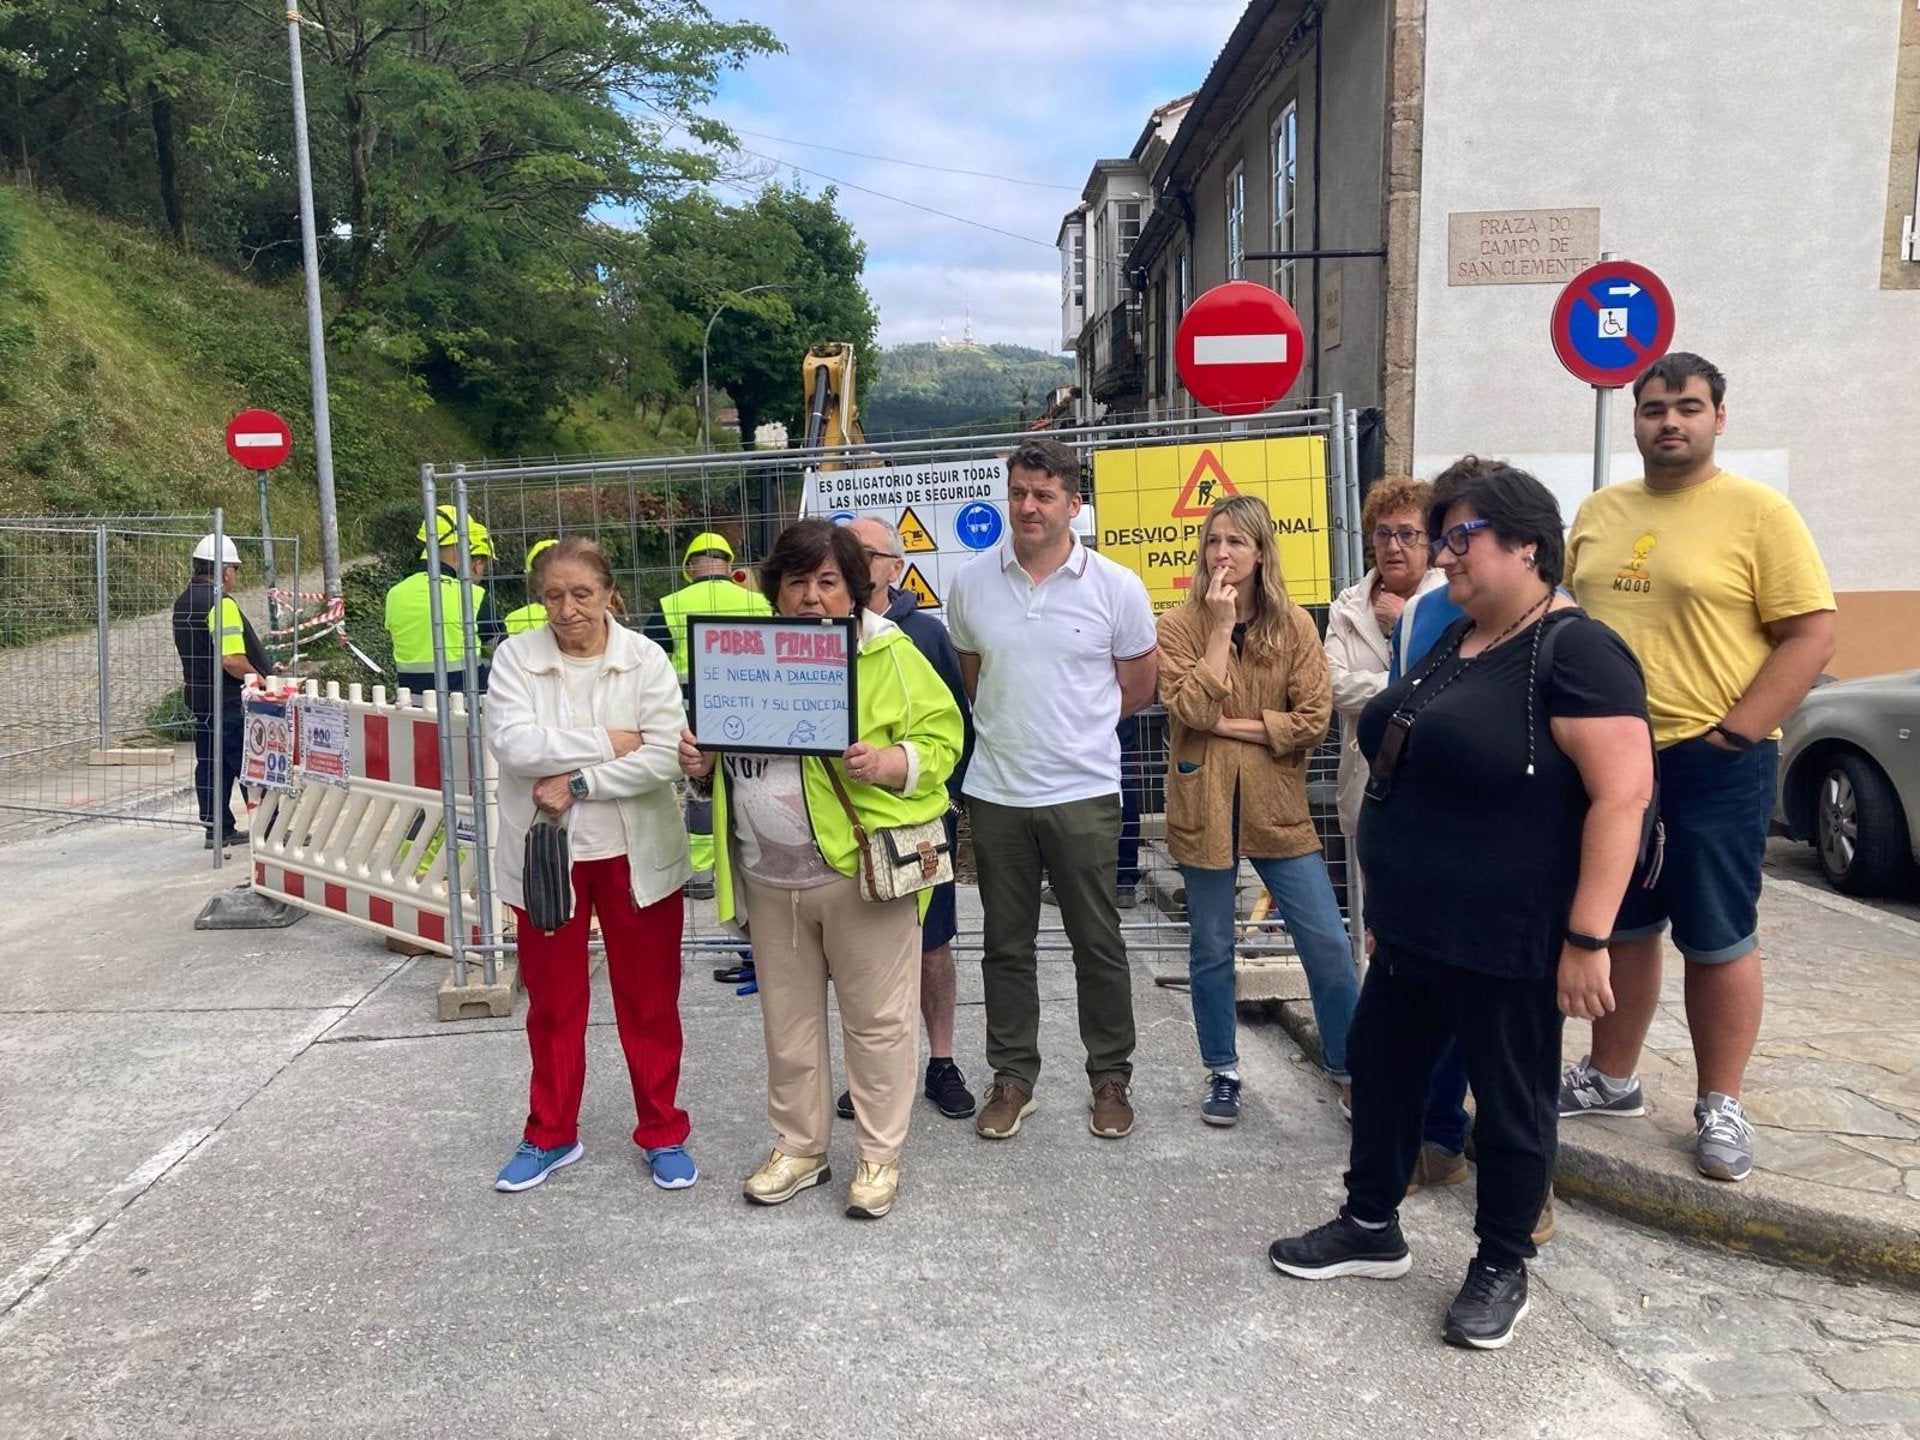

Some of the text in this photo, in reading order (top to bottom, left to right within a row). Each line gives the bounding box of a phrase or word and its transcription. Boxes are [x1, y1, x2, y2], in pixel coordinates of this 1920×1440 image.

[1480, 216, 1571, 235] PRAZA DO
[1480, 237, 1570, 256] CAMPO DE
[1458, 261, 1496, 278] SAN
[819, 466, 1001, 493] ES OBLIGATORIO SEGUIR TODAS
[829, 484, 991, 509] LAS NORMAS DE SEGURIDAD
[1104, 525, 1178, 546] DESVIO
[1148, 549, 1198, 568] PARA
[1613, 578, 1651, 593] MOOD
[775, 631, 847, 659] POMBAL
[704, 666, 844, 684] SE NIEGAN A DIALOGAR
[703, 693, 849, 712] GORETTI Y SU CONCEJAL
